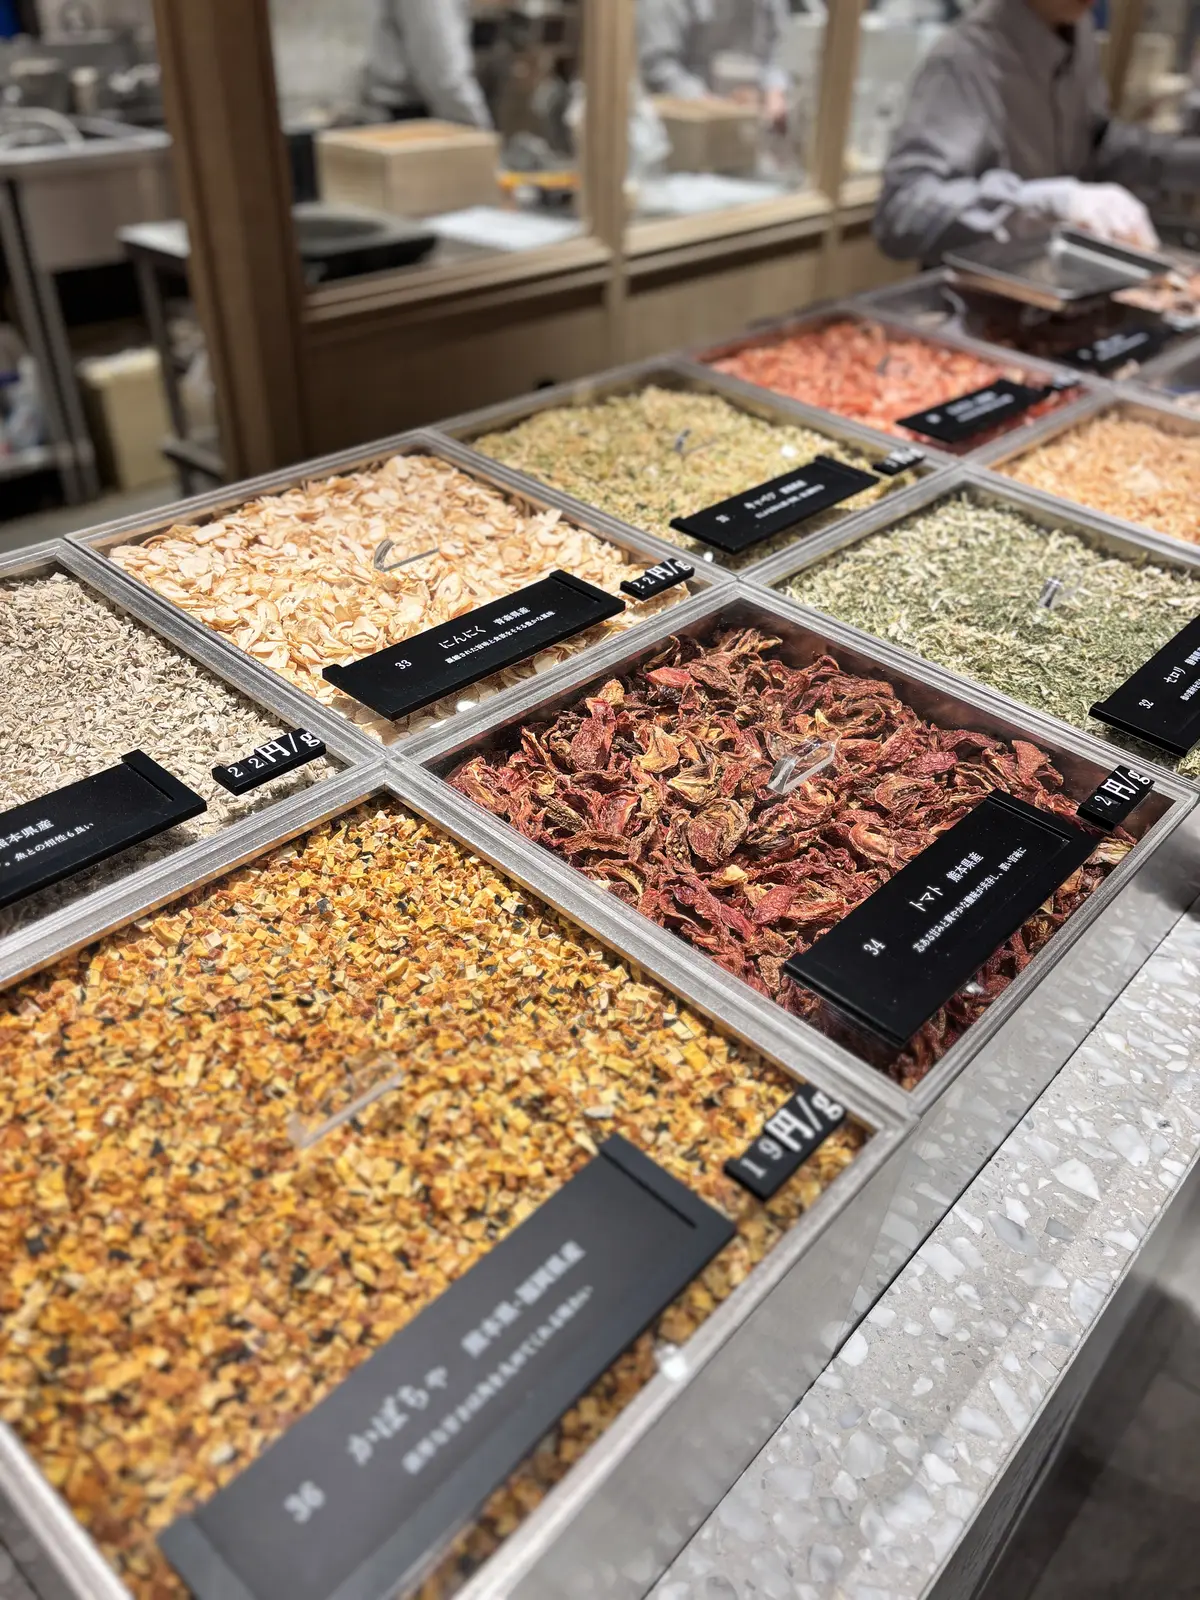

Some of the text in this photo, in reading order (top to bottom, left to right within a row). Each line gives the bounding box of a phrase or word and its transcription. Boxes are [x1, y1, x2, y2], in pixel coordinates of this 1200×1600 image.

[438, 624, 487, 650] にんにく
[394, 658, 413, 671] 33
[1162, 665, 1187, 684] セロリ
[909, 850, 985, 913] トマト 熊本県産
[862, 937, 887, 957] 34
[348, 1365, 448, 1466] かぼちゃ
